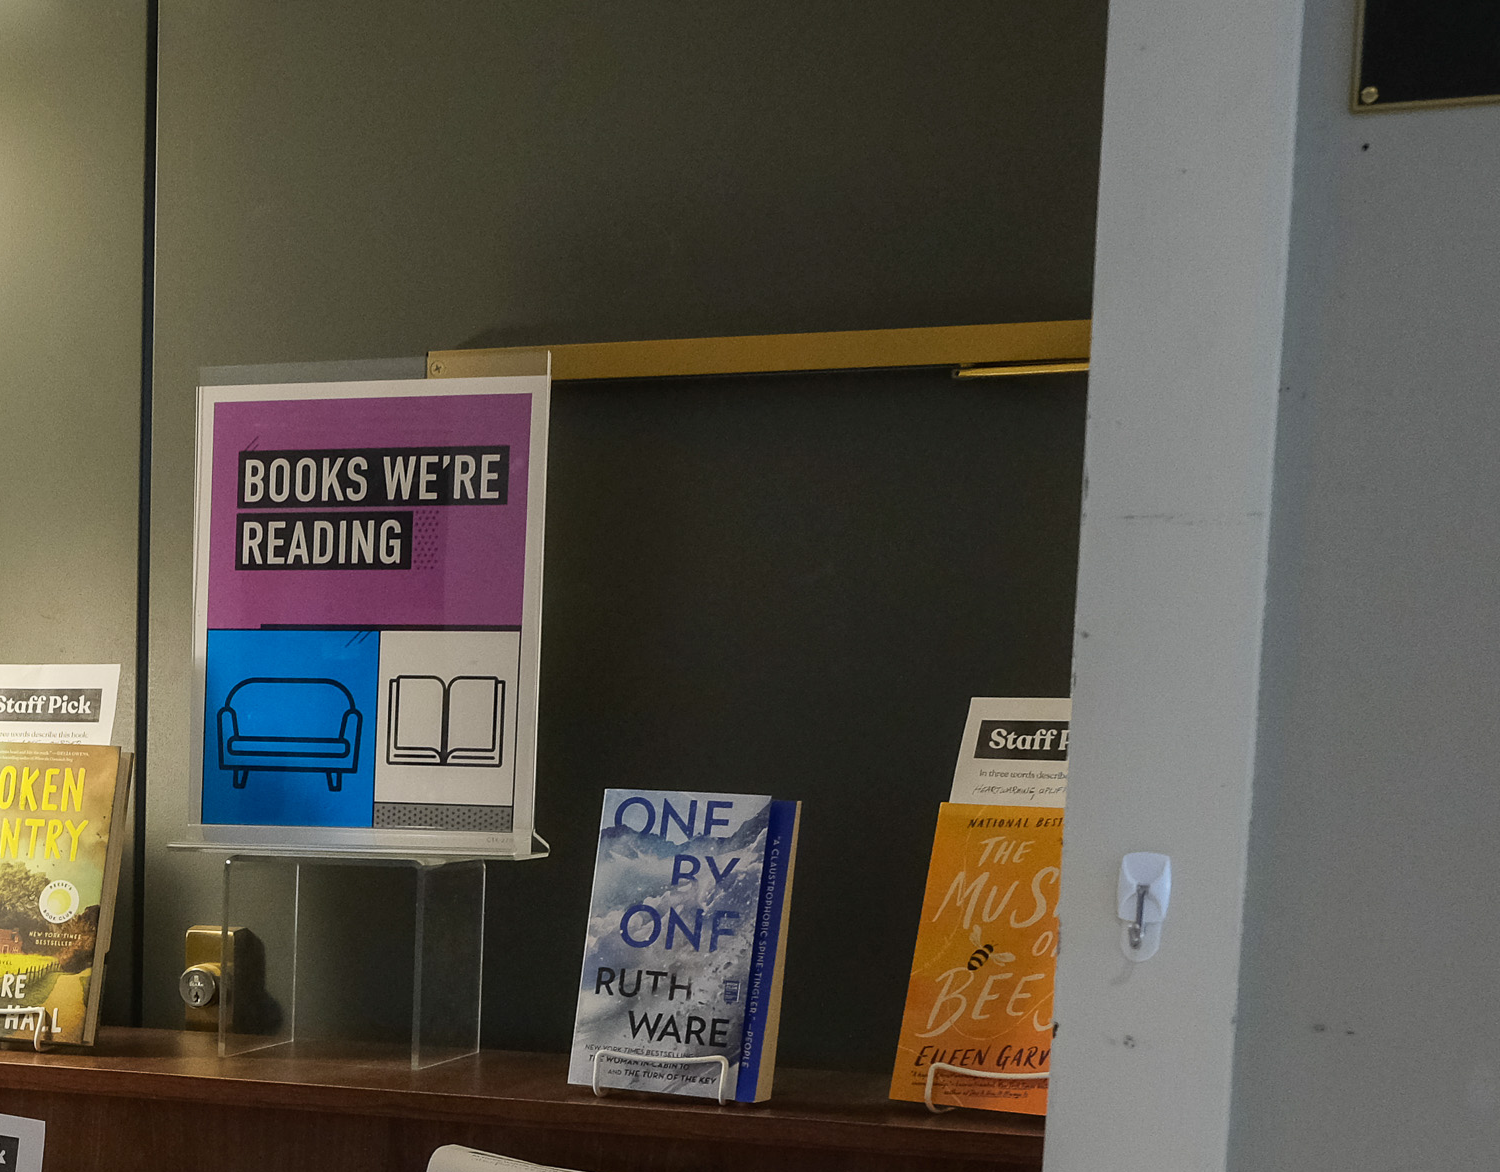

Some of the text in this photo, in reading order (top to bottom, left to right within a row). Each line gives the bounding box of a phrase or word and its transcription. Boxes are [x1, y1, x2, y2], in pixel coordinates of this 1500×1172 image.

[243, 453, 501, 503] BOOKS WE'RE
[241, 519, 402, 565] READING
[47, 694, 92, 714] Pick
[988, 727, 1058, 751] Staff
[966, 817, 1030, 830] NATIONAL
[978, 835, 1037, 868] THE
[594, 967, 693, 1002] RUTH
[627, 1010, 730, 1049] WARE
[914, 1045, 992, 1068] EILEEN
